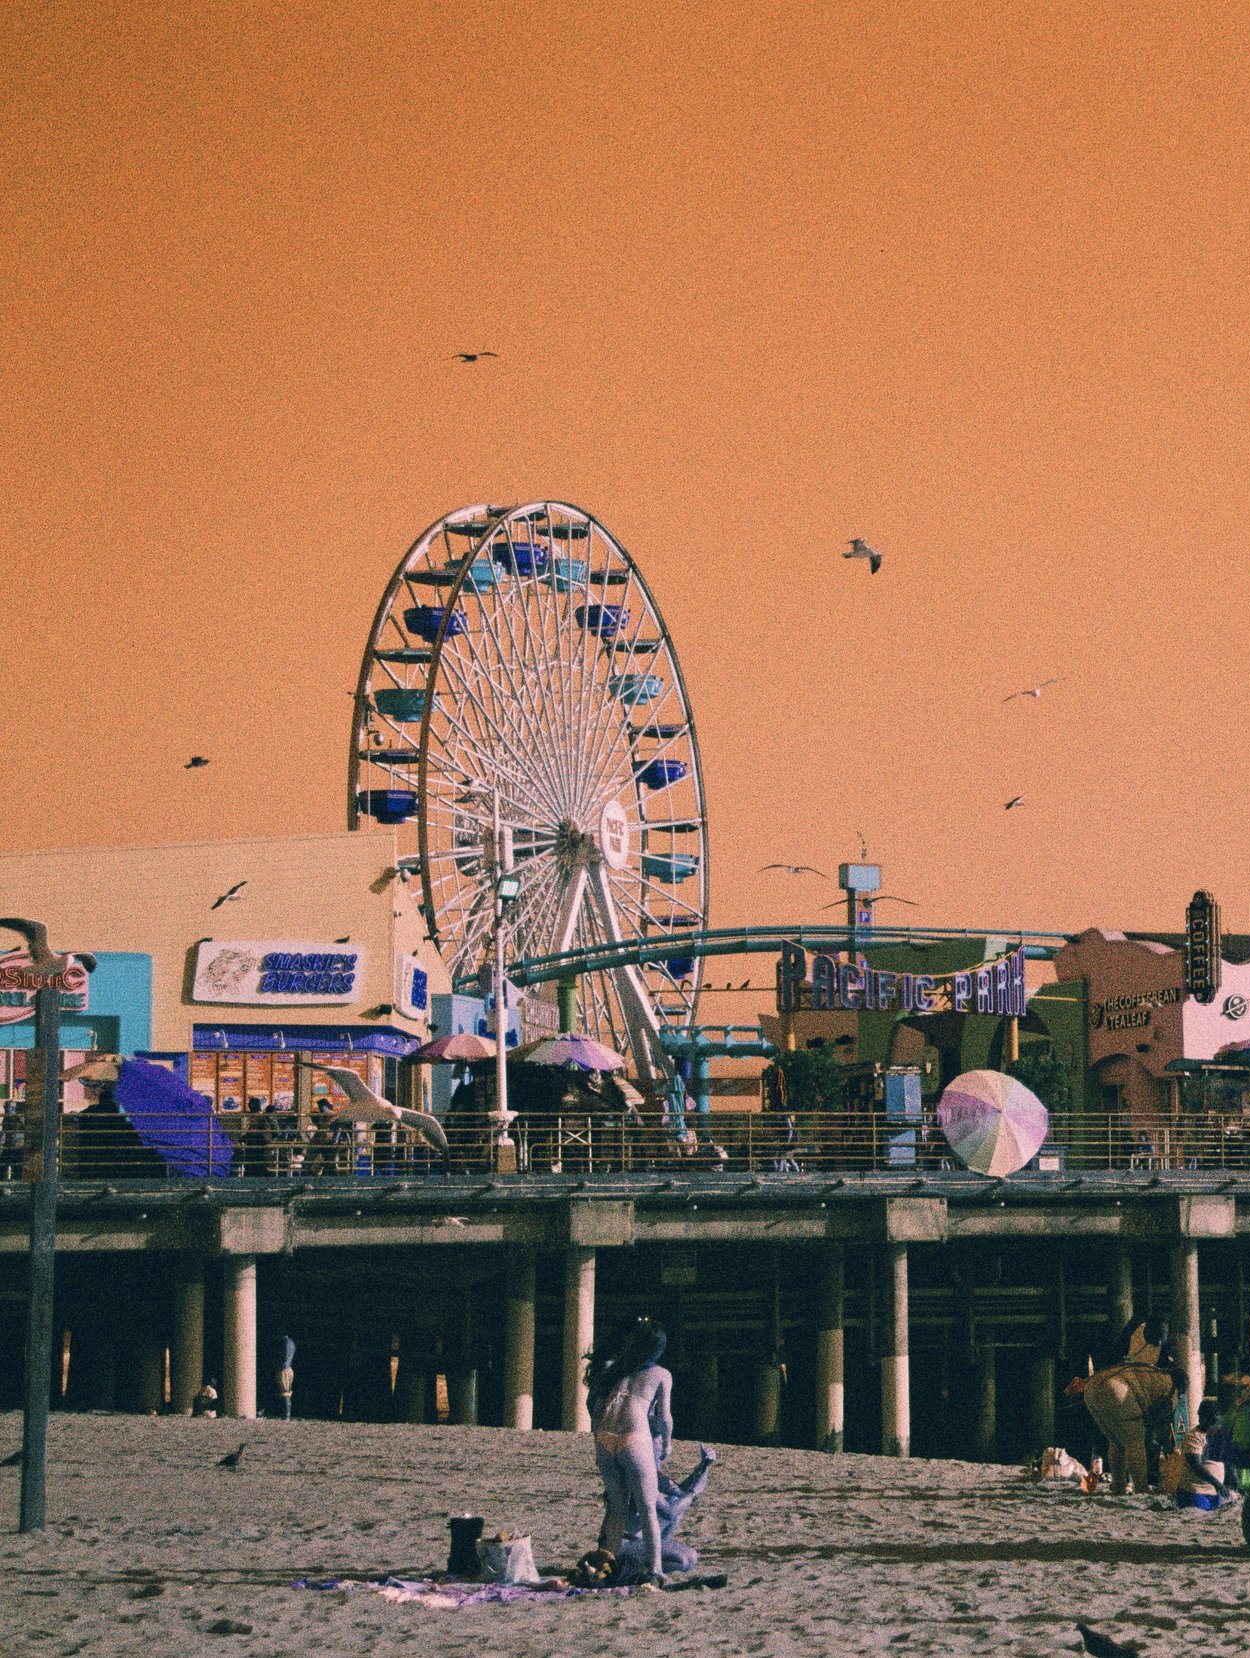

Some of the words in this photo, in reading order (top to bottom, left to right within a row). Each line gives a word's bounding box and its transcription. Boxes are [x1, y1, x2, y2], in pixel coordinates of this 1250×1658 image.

[258, 973, 356, 993] BURGERS
[779, 938, 934, 1011] PACIFIC
[953, 944, 1026, 1016] PARK
[1192, 919, 1205, 989] COFFEE
